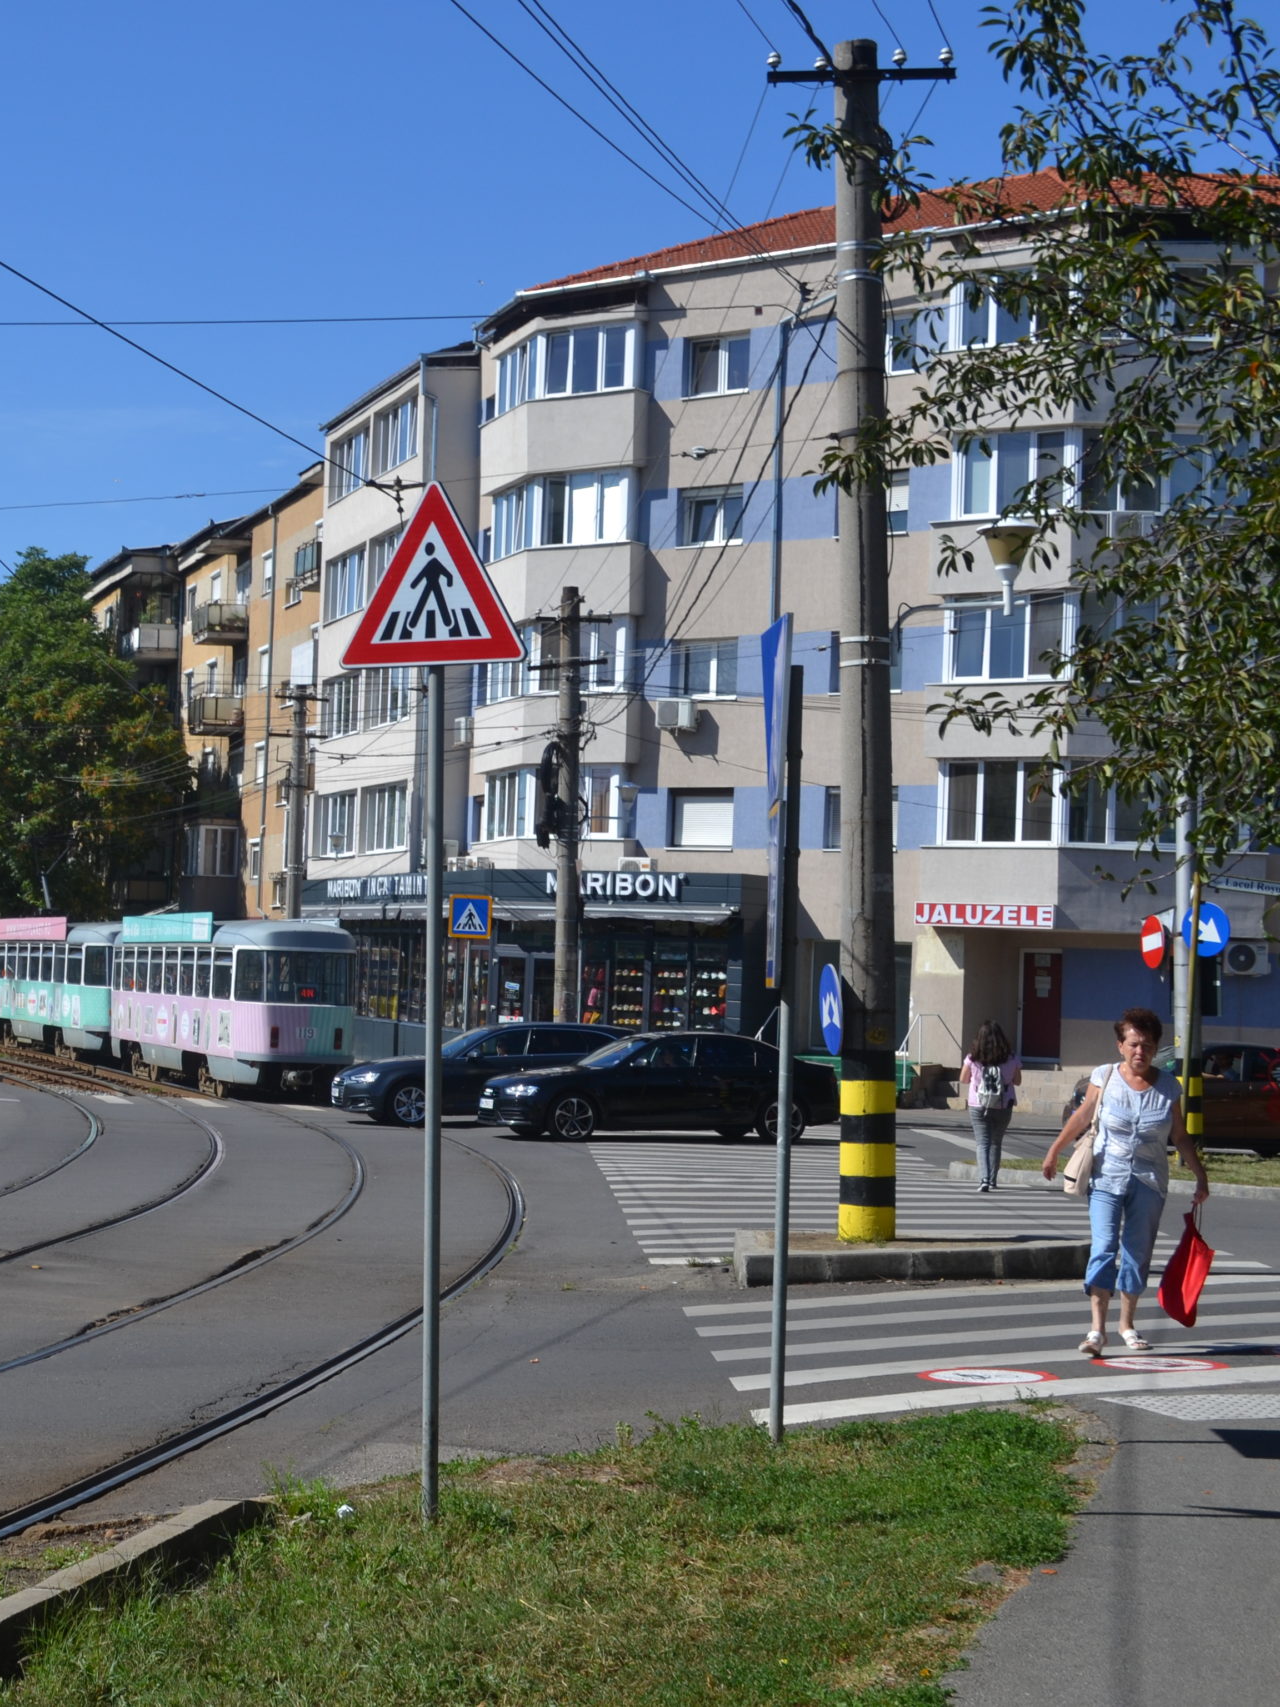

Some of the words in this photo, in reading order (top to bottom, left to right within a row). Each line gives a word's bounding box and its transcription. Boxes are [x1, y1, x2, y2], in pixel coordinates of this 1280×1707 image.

[327, 878, 361, 898] MARIBON
[916, 903, 1052, 926] JALUZELE
[298, 1027, 315, 1039] 119
